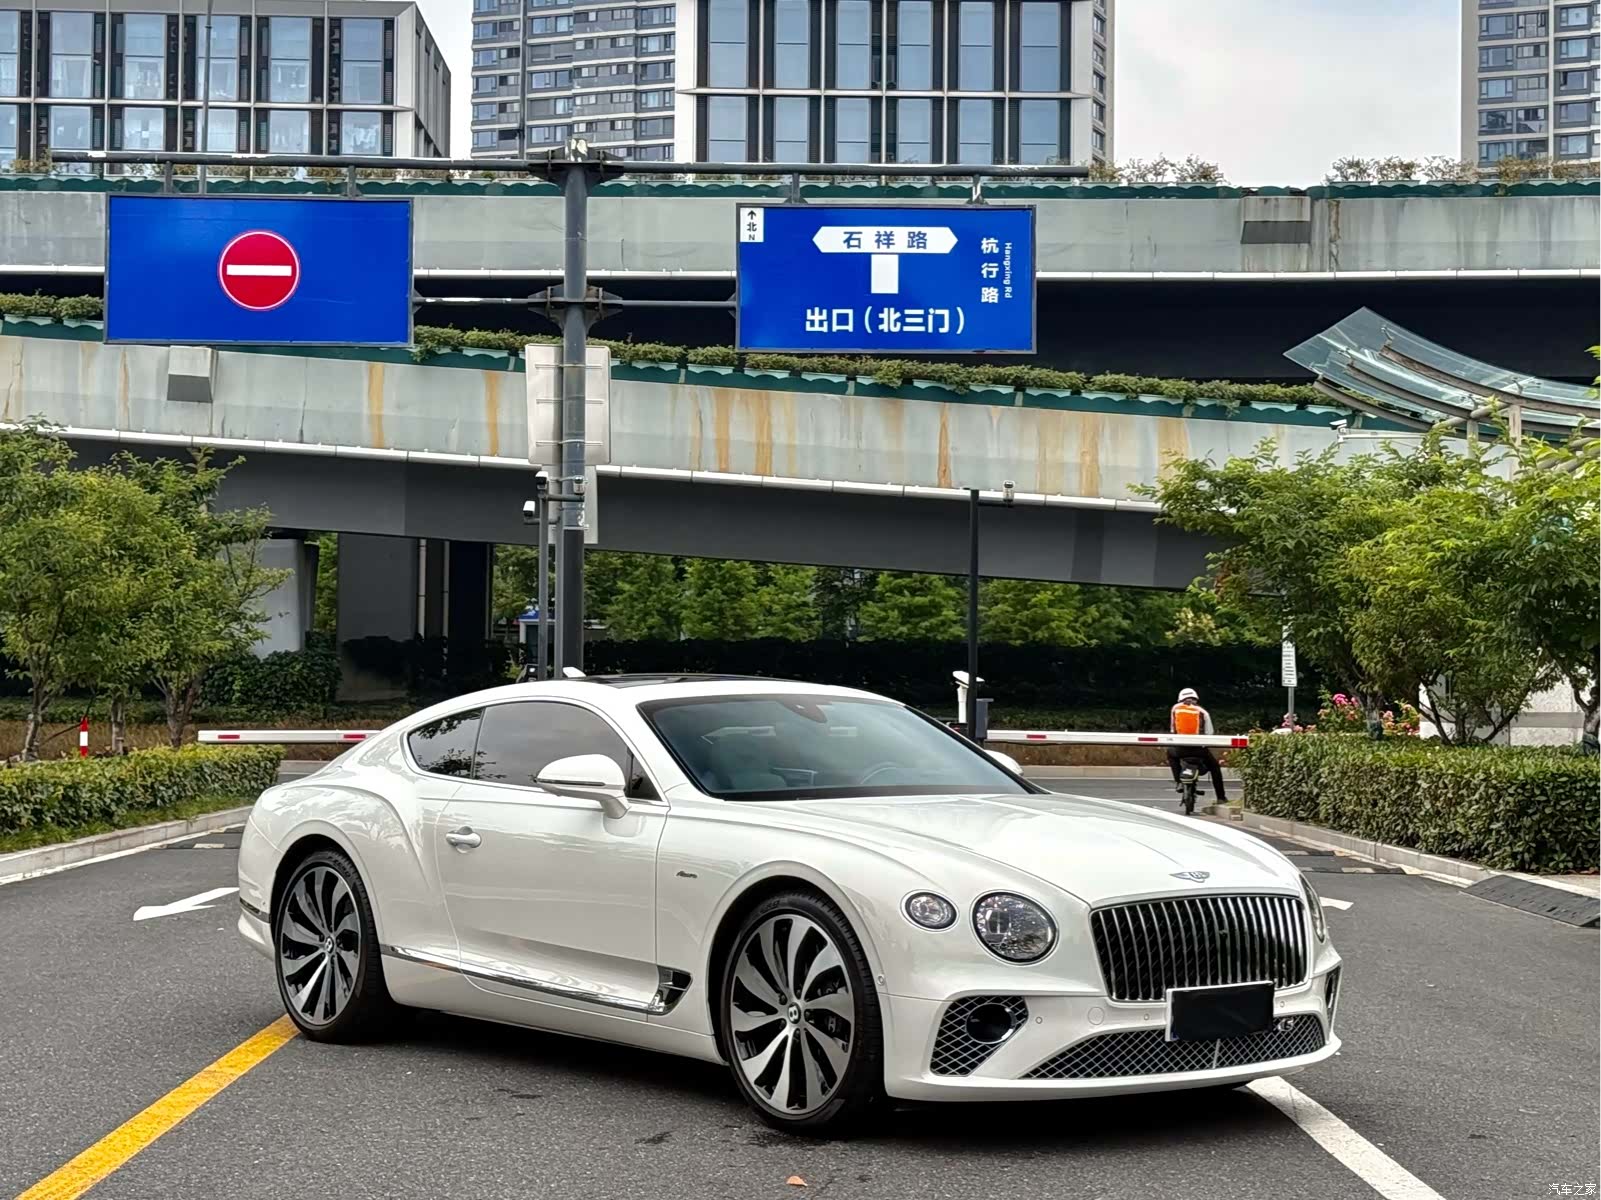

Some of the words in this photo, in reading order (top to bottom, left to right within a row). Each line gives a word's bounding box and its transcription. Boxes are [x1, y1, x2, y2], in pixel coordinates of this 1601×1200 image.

[746, 221, 757, 232] 北
[748, 233, 756, 241] N
[843, 230, 928, 250] 石祥路
[980, 237, 1000, 304] 杭行路
[1003, 242, 1013, 285] Hangxing
[1004, 286, 1013, 299] Rd
